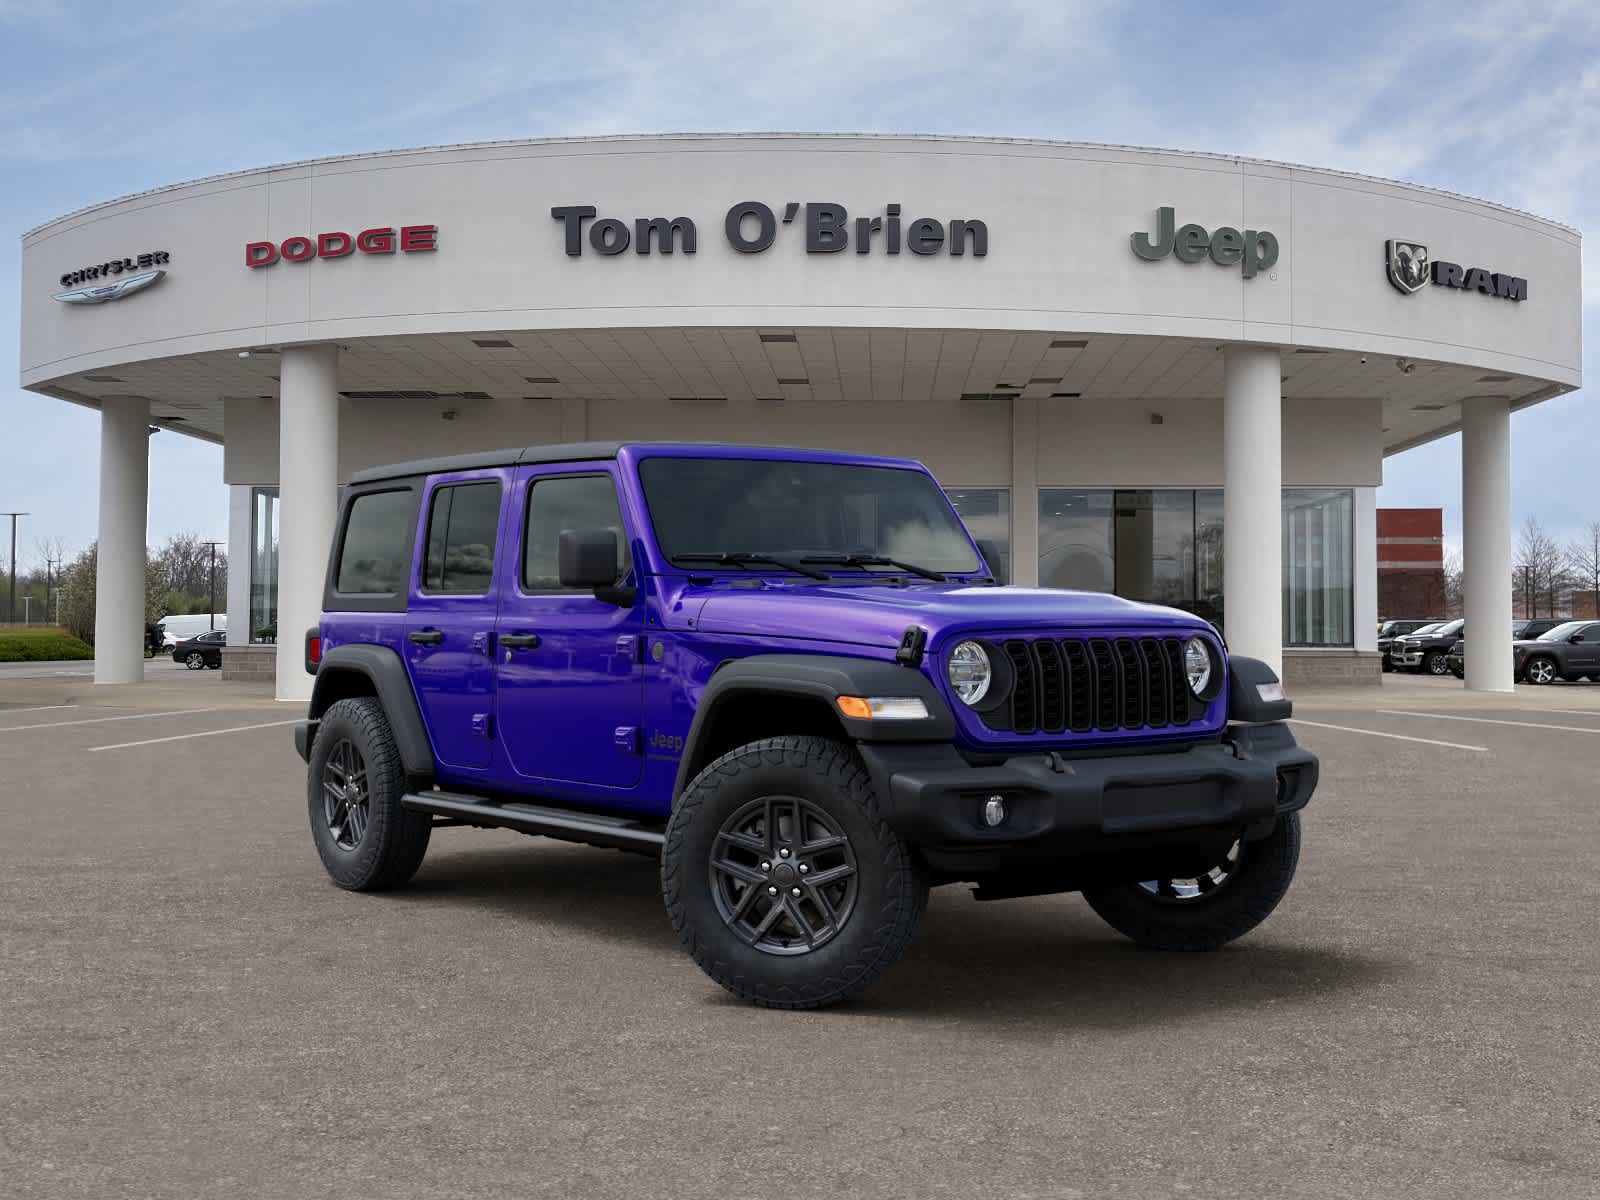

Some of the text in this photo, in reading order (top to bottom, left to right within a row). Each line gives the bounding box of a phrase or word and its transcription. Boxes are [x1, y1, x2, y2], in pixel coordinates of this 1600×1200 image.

[245, 225, 437, 268] DODGE
[551, 201, 988, 256] Tom O'Brien
[1131, 207, 1279, 278] Jeep
[60, 250, 169, 286] CHRYSLER
[1431, 260, 1528, 301] RAM
[649, 728, 683, 752] Jeep
